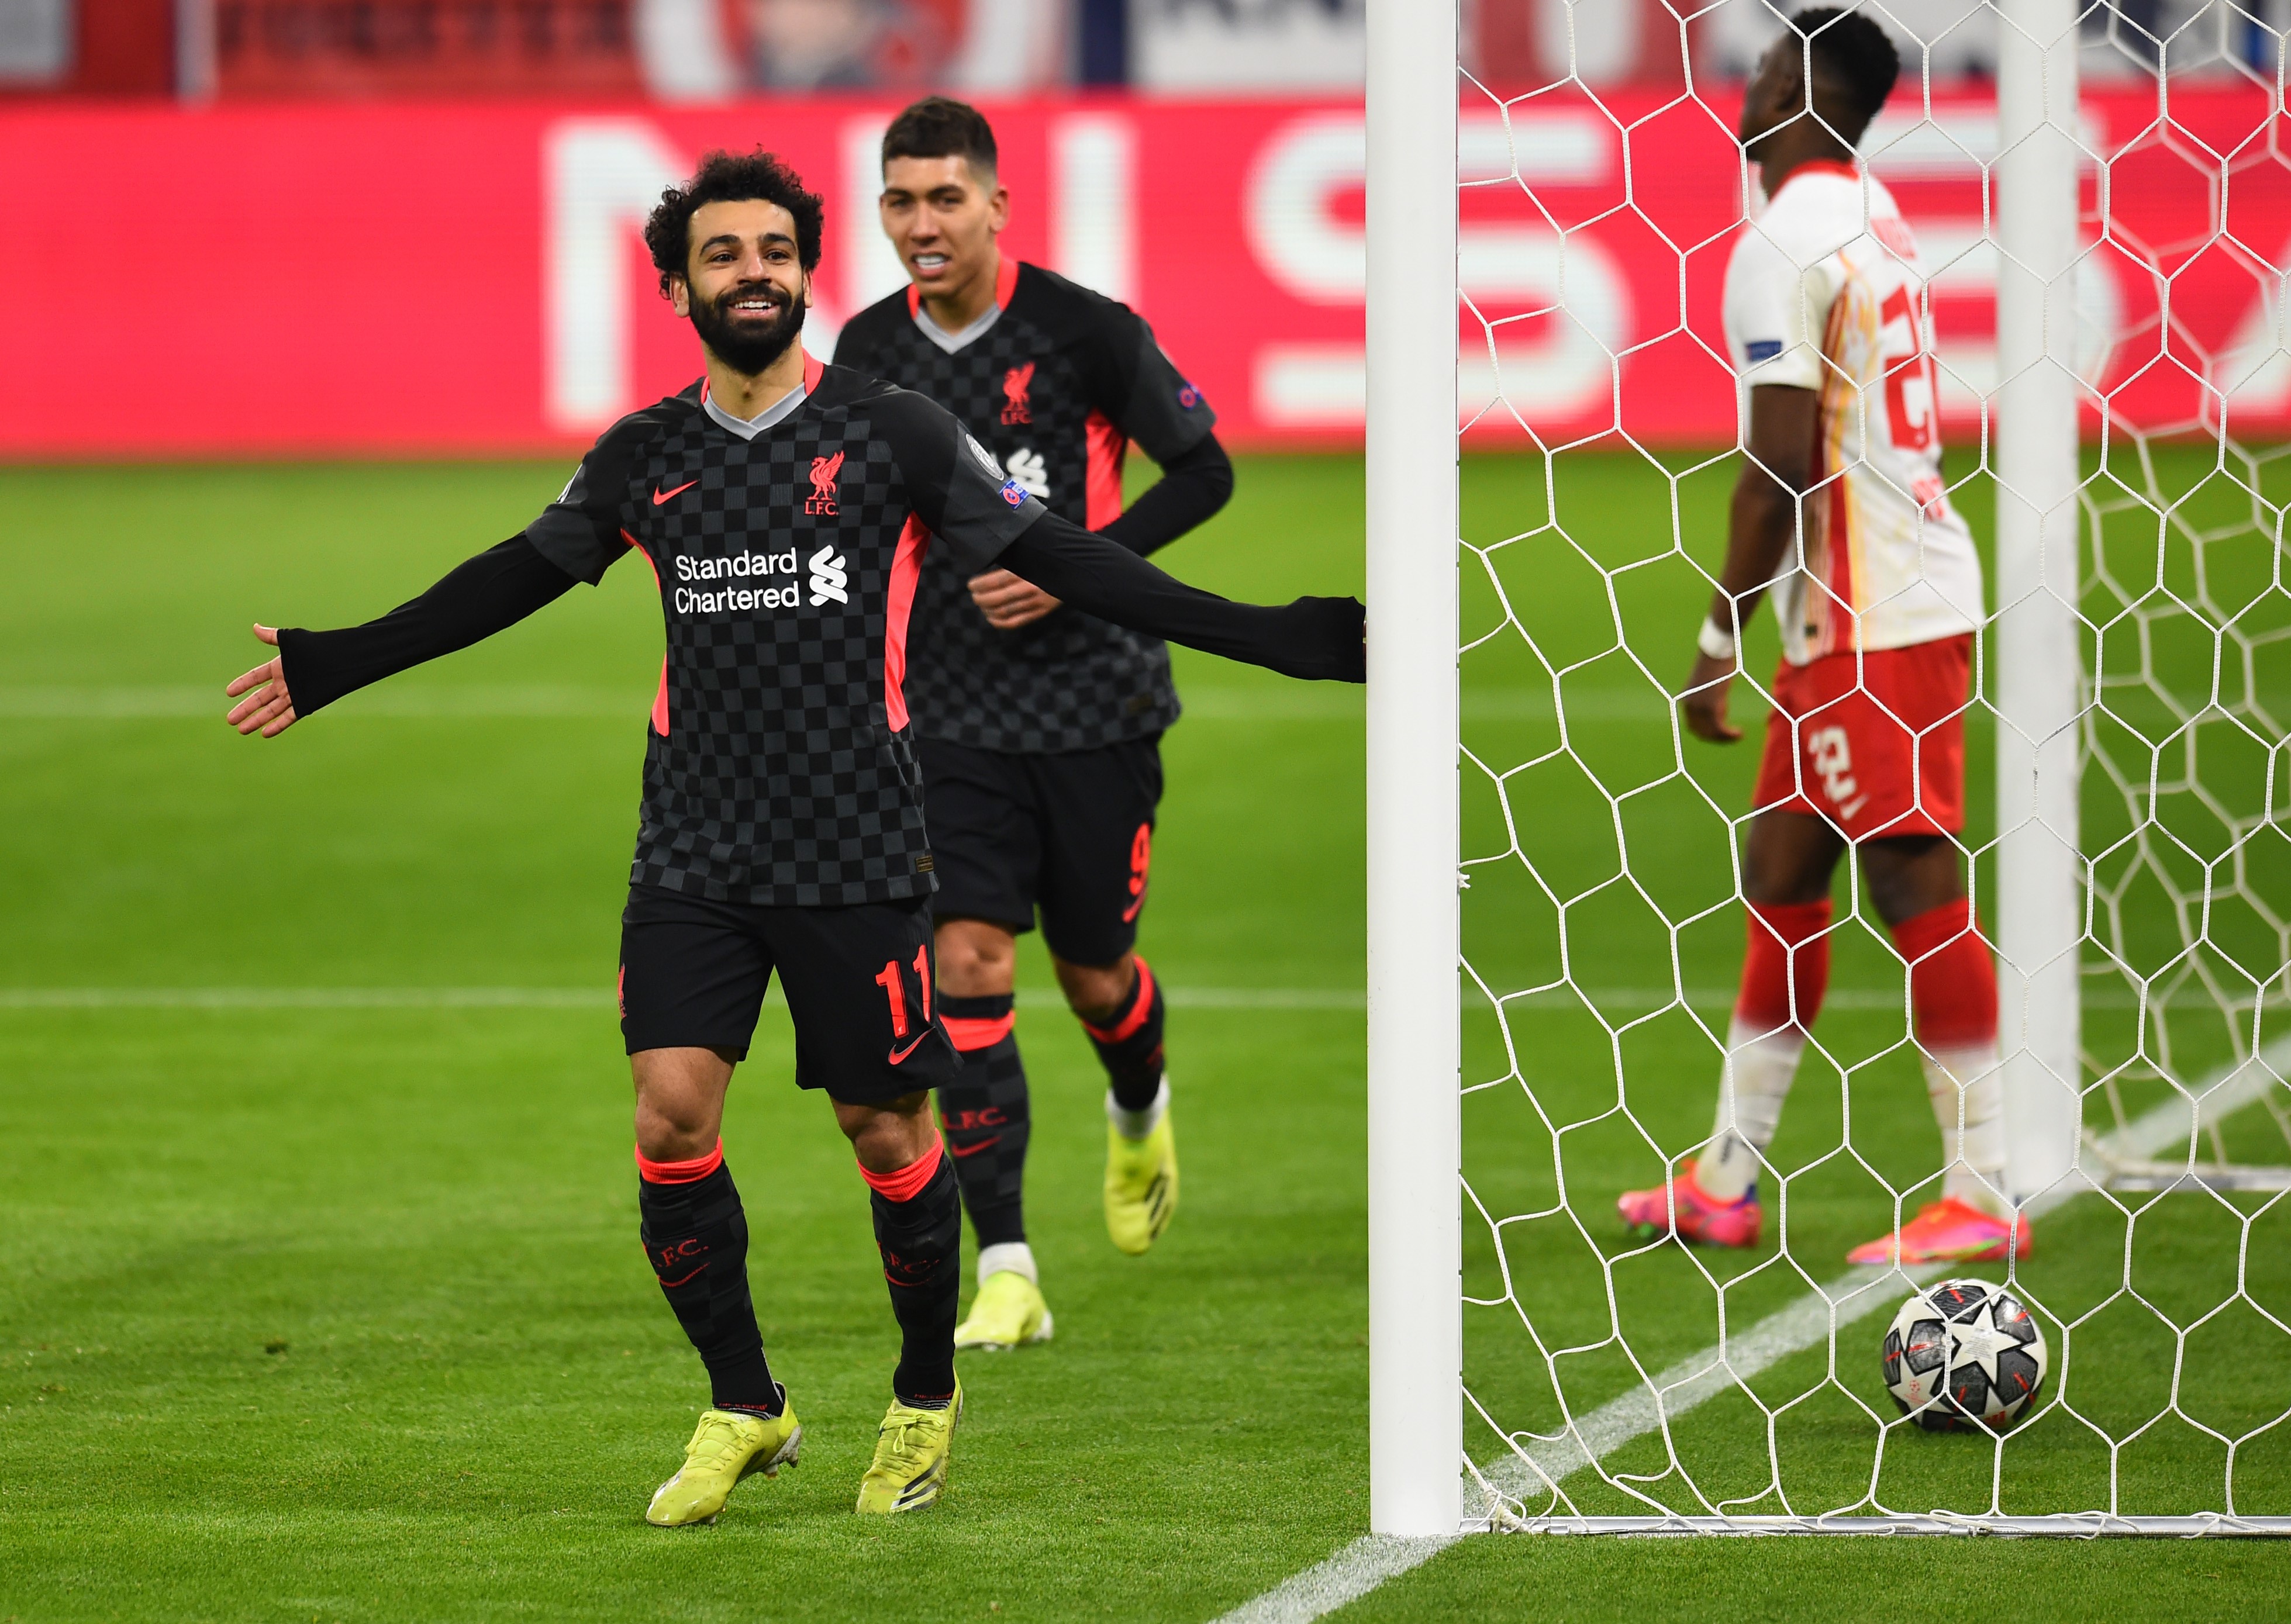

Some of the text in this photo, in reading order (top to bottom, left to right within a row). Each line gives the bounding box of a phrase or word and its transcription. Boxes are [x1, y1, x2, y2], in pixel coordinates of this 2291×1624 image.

[1881, 283, 1938, 451] 2
[805, 501, 839, 515] L.F.C.
[675, 547, 798, 581] Standard
[675, 580, 800, 614] Chartered
[1128, 821, 1151, 897] 9
[875, 944, 931, 1039] 11
